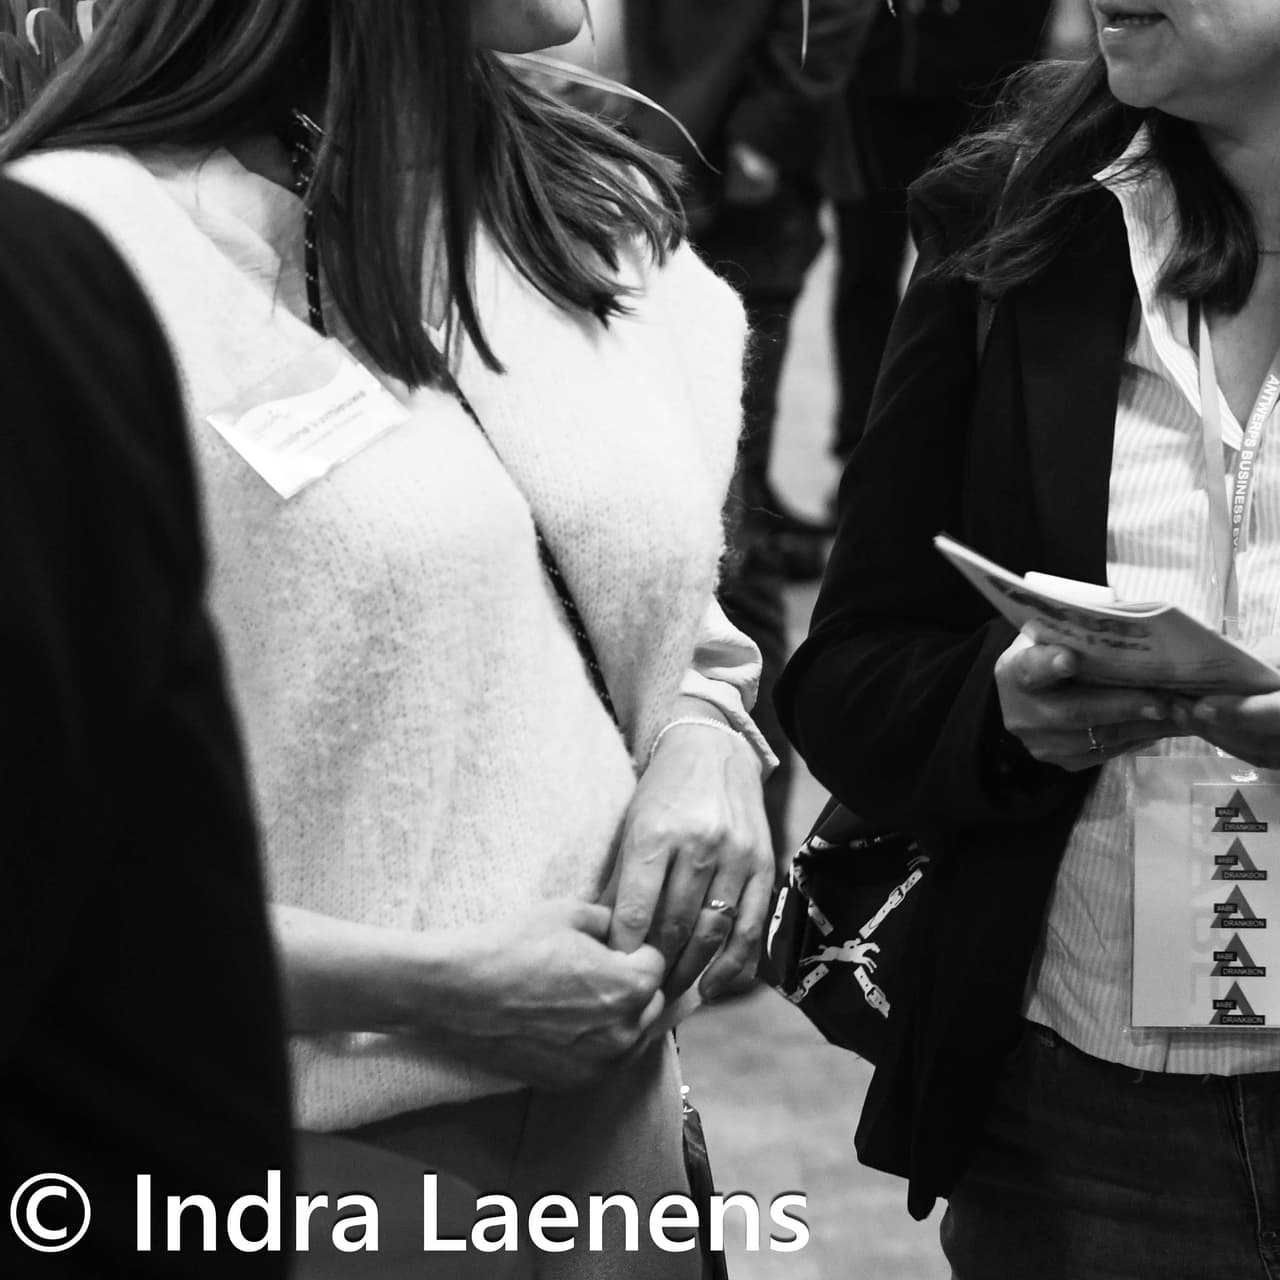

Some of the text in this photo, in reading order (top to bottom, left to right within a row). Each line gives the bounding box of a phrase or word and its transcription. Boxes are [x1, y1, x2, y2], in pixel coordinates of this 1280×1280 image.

[1243, 373, 1280, 447] ANTWERPS
[1232, 450, 1254, 524] BUSINESS
[1223, 822, 1267, 831] DRANKBON
[1222, 871, 1266, 880] DRANKBON
[1222, 919, 1266, 928] DRANKBON
[1221, 967, 1265, 976] DRANKBON
[1220, 1015, 1264, 1024] DRANKBON
